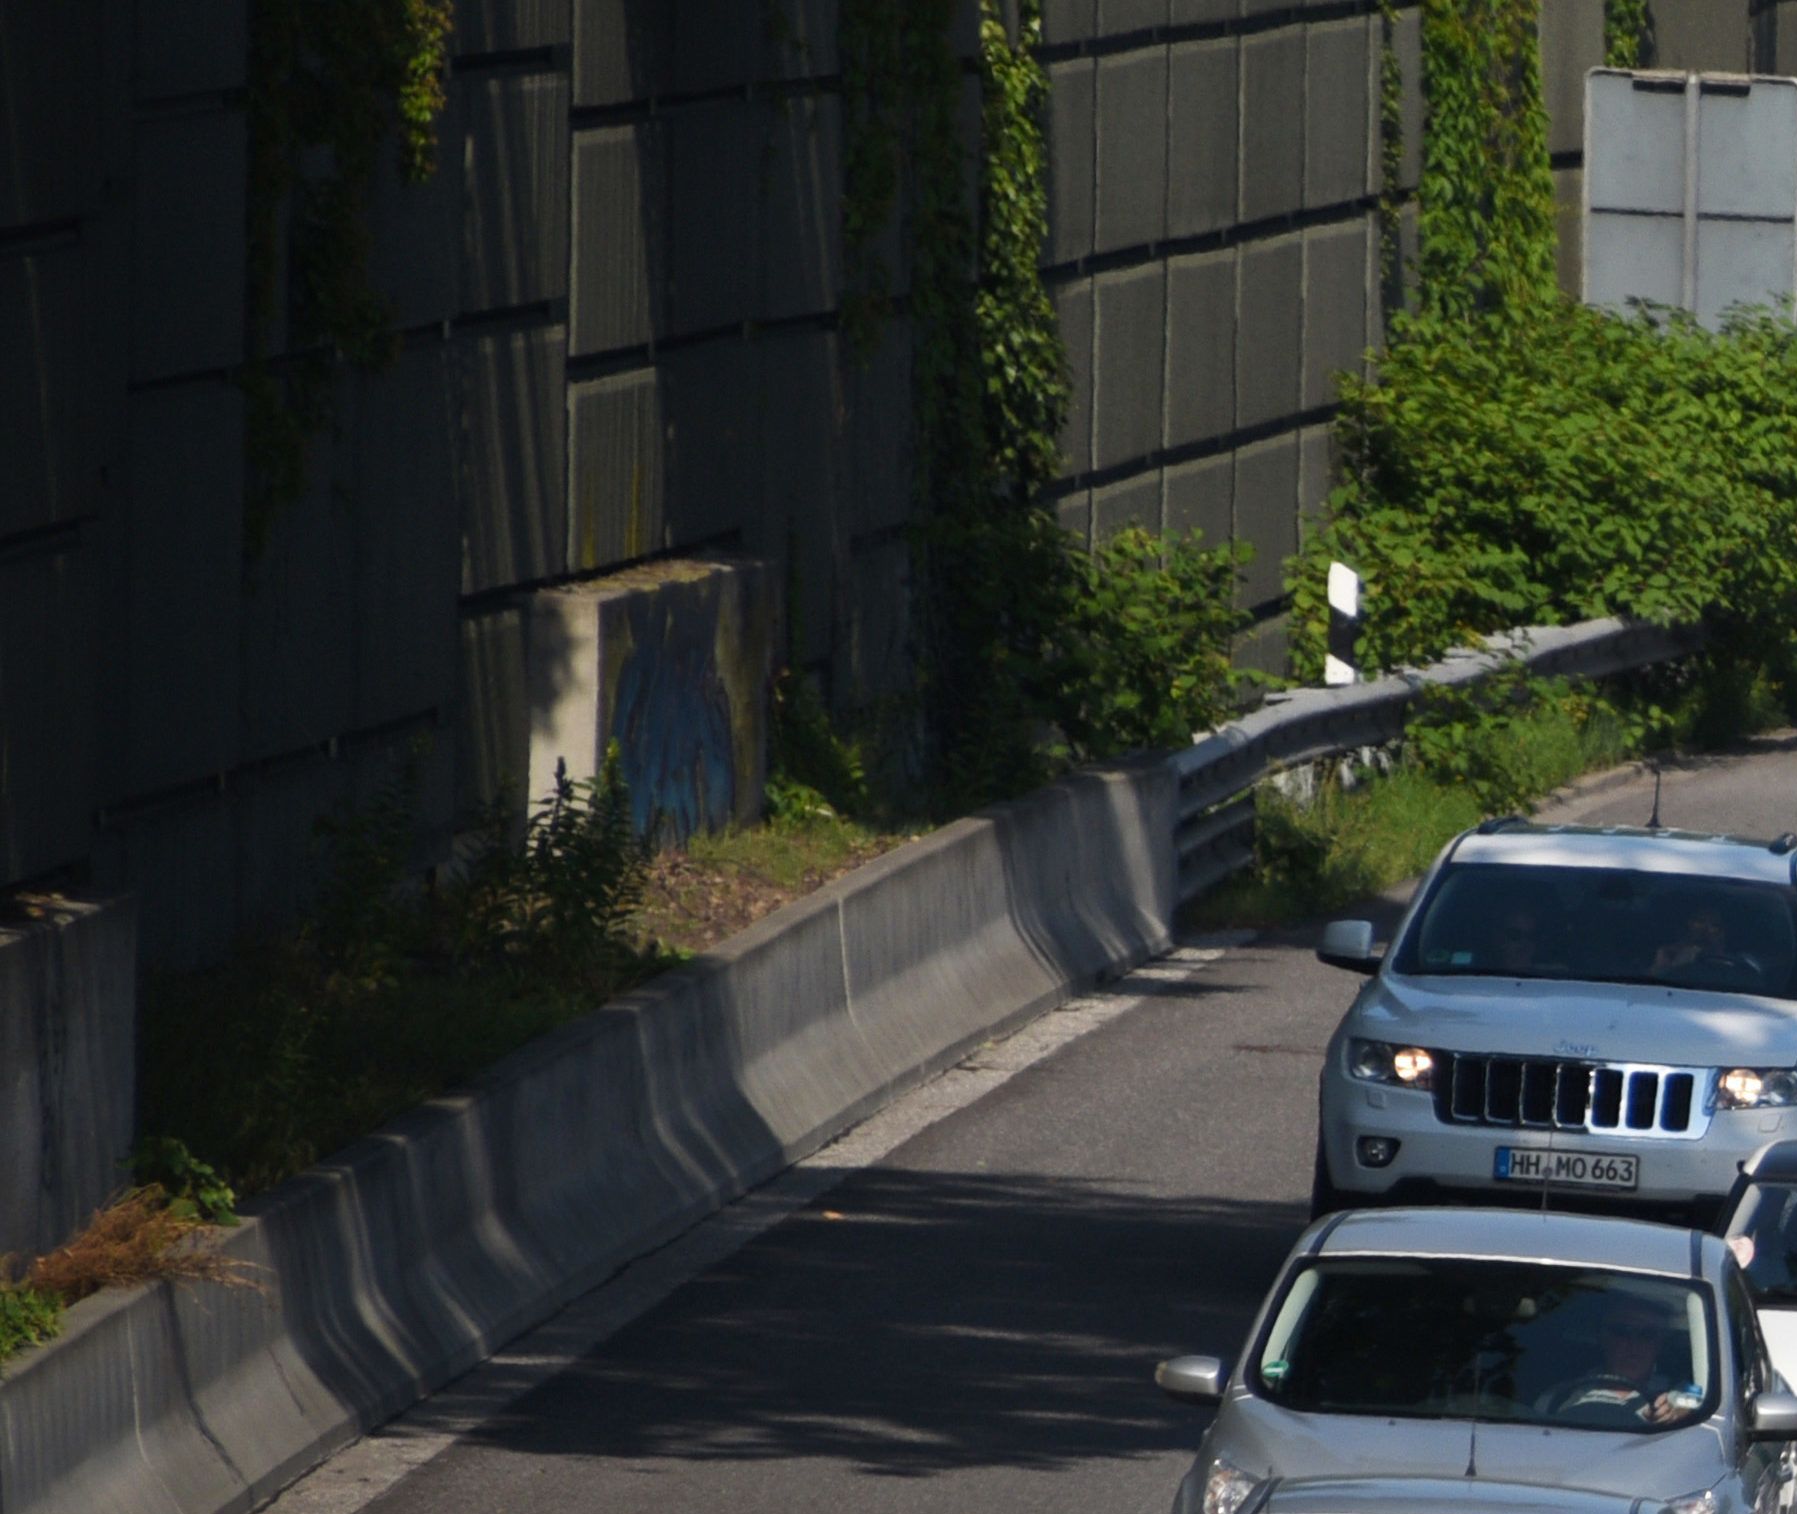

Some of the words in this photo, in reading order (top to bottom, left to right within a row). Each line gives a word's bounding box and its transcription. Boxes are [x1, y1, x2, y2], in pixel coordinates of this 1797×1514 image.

[1511, 1153, 1541, 1175] HH
[1555, 1155, 1587, 1179] MO
[1591, 1158, 1634, 1182] 663
